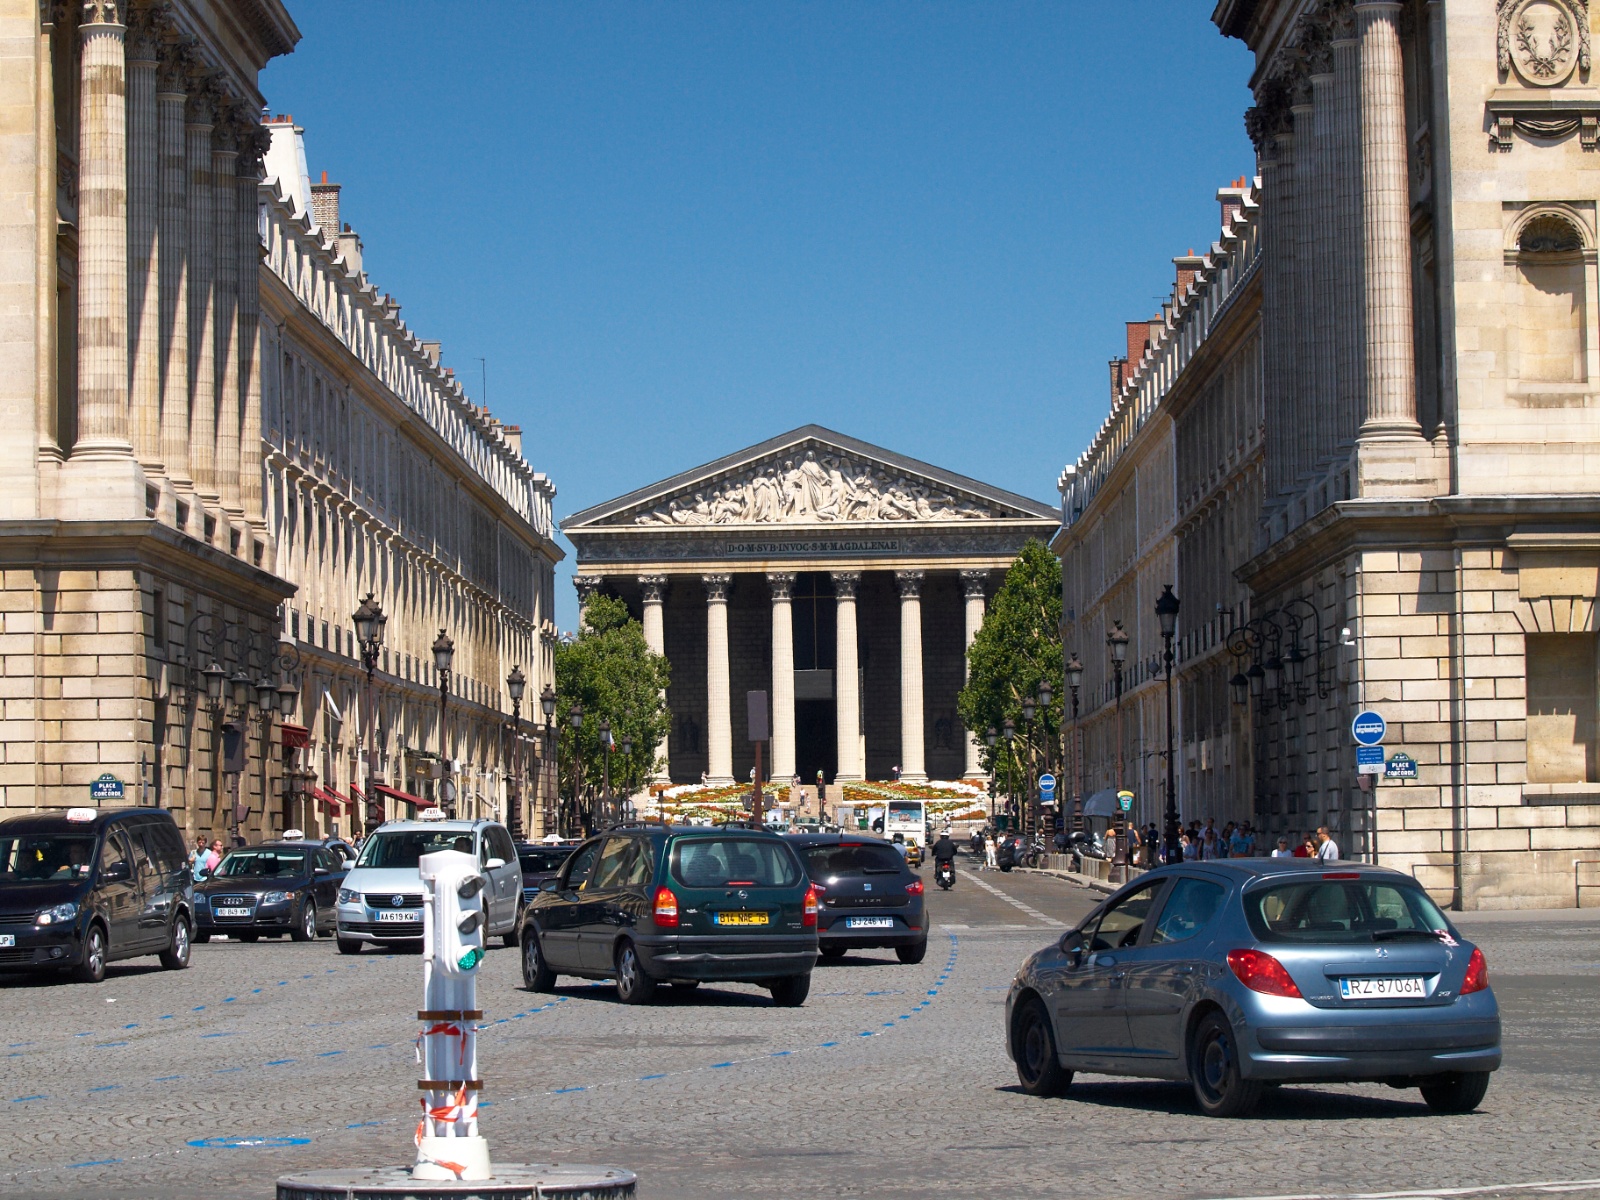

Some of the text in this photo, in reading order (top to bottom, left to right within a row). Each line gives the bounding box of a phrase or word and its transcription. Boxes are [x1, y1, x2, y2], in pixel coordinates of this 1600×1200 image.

[380, 913, 389, 921] AA
[389, 913, 404, 921] 619
[720, 912, 767, 923] 814 NAE 75
[863, 917, 878, 926] 246
[878, 917, 888, 925] VT
[1351, 978, 1422, 994] RZ 8706A
